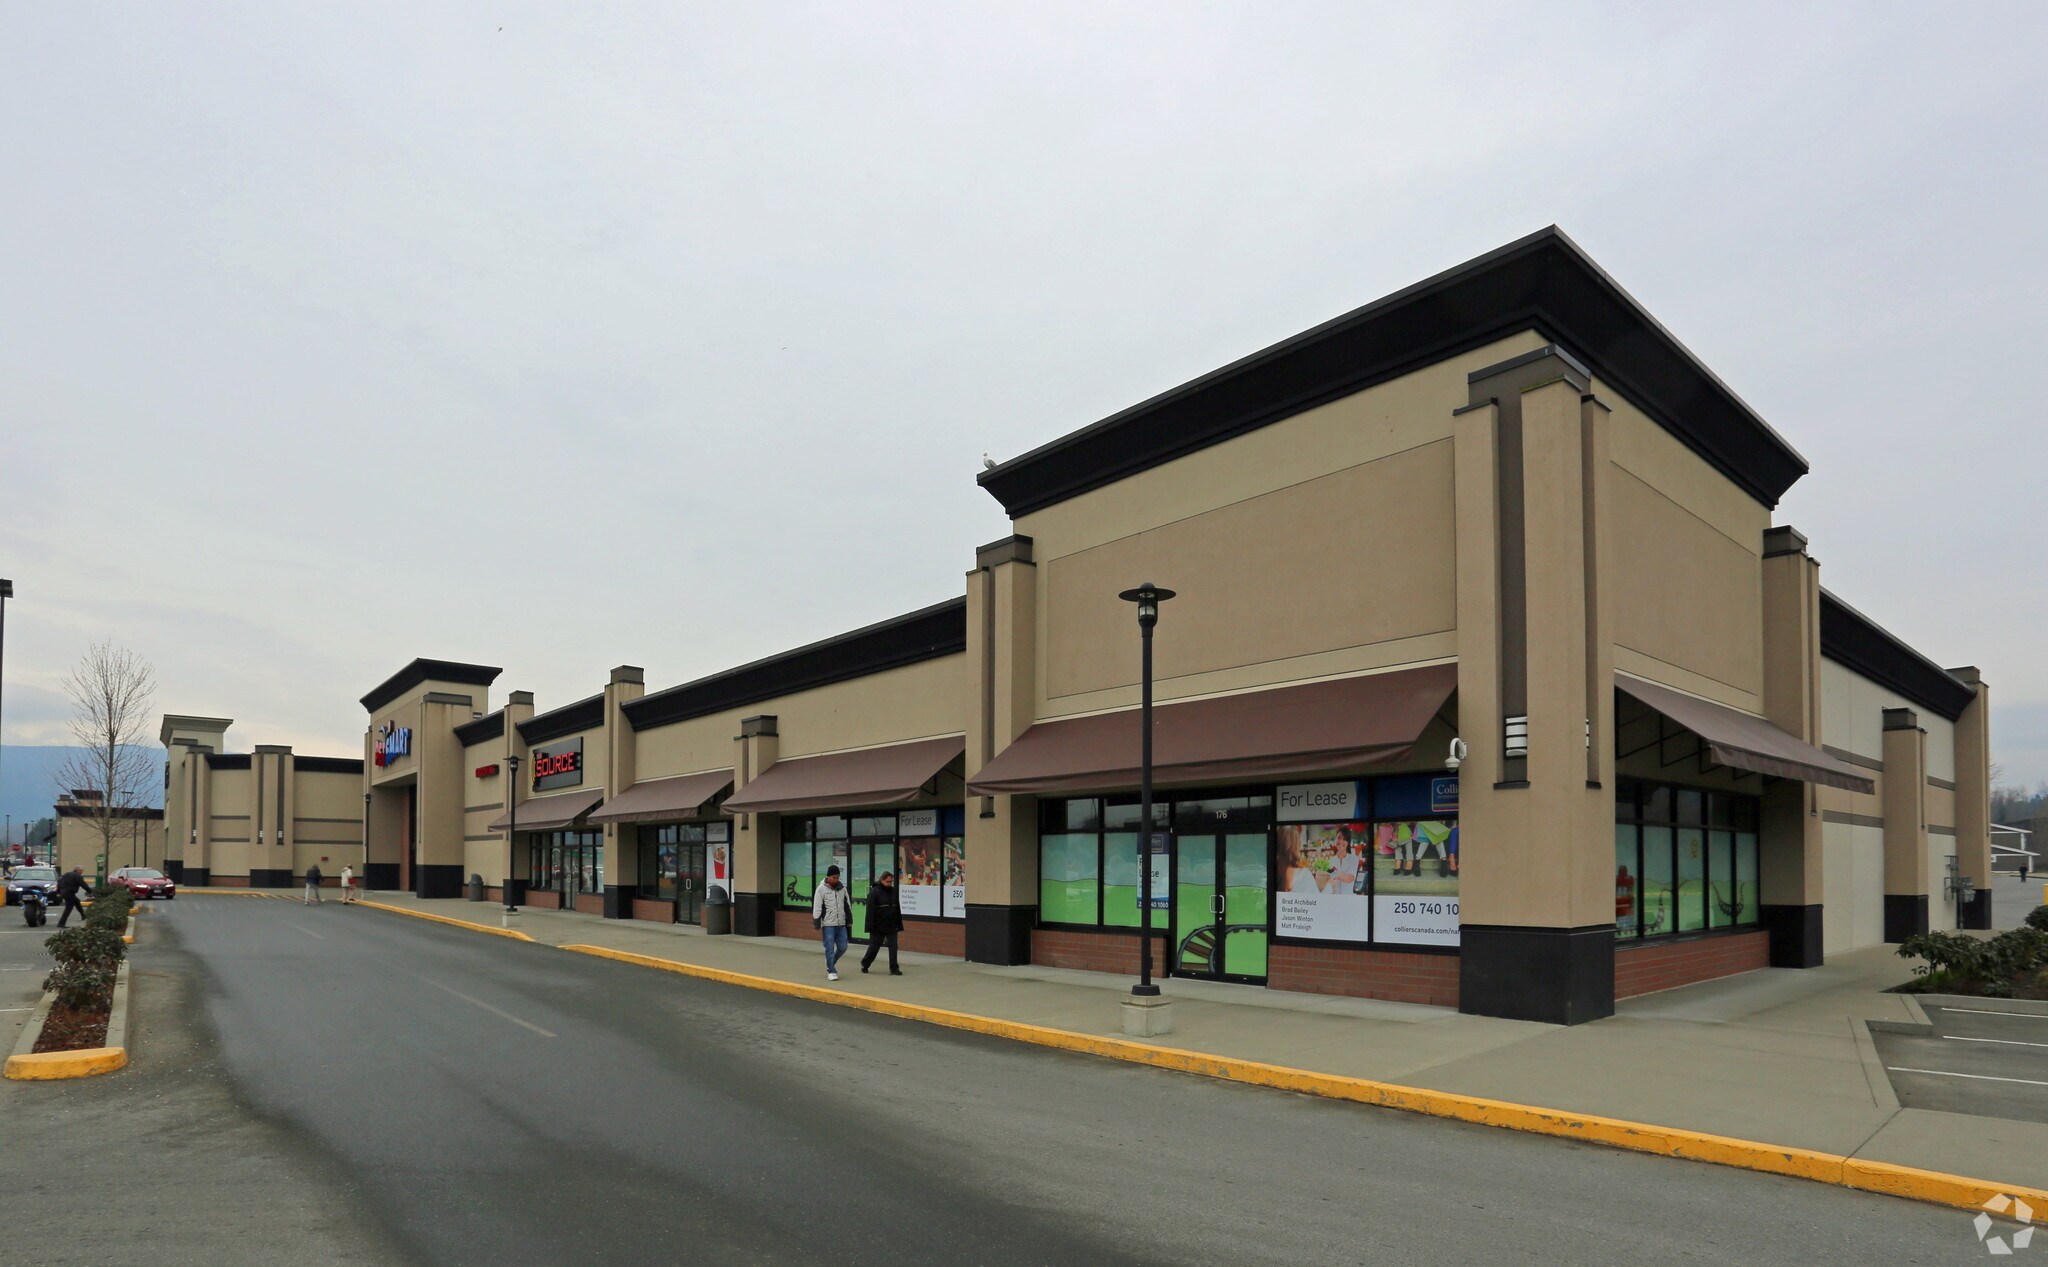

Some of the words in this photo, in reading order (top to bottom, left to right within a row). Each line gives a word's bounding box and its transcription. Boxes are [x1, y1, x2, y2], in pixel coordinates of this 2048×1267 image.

[536, 752, 575, 777] SOURCE
[1281, 791, 1303, 807] For
[1306, 790, 1347, 807] Lease
[1215, 810, 1228, 819] 176
[901, 815, 911, 826] For
[913, 815, 932, 826] Lease
[952, 890, 963, 898] 250
[1294, 907, 1308, 915] Bailey
[1394, 902, 1416, 914] 250
[1420, 902, 1442, 915] 740
